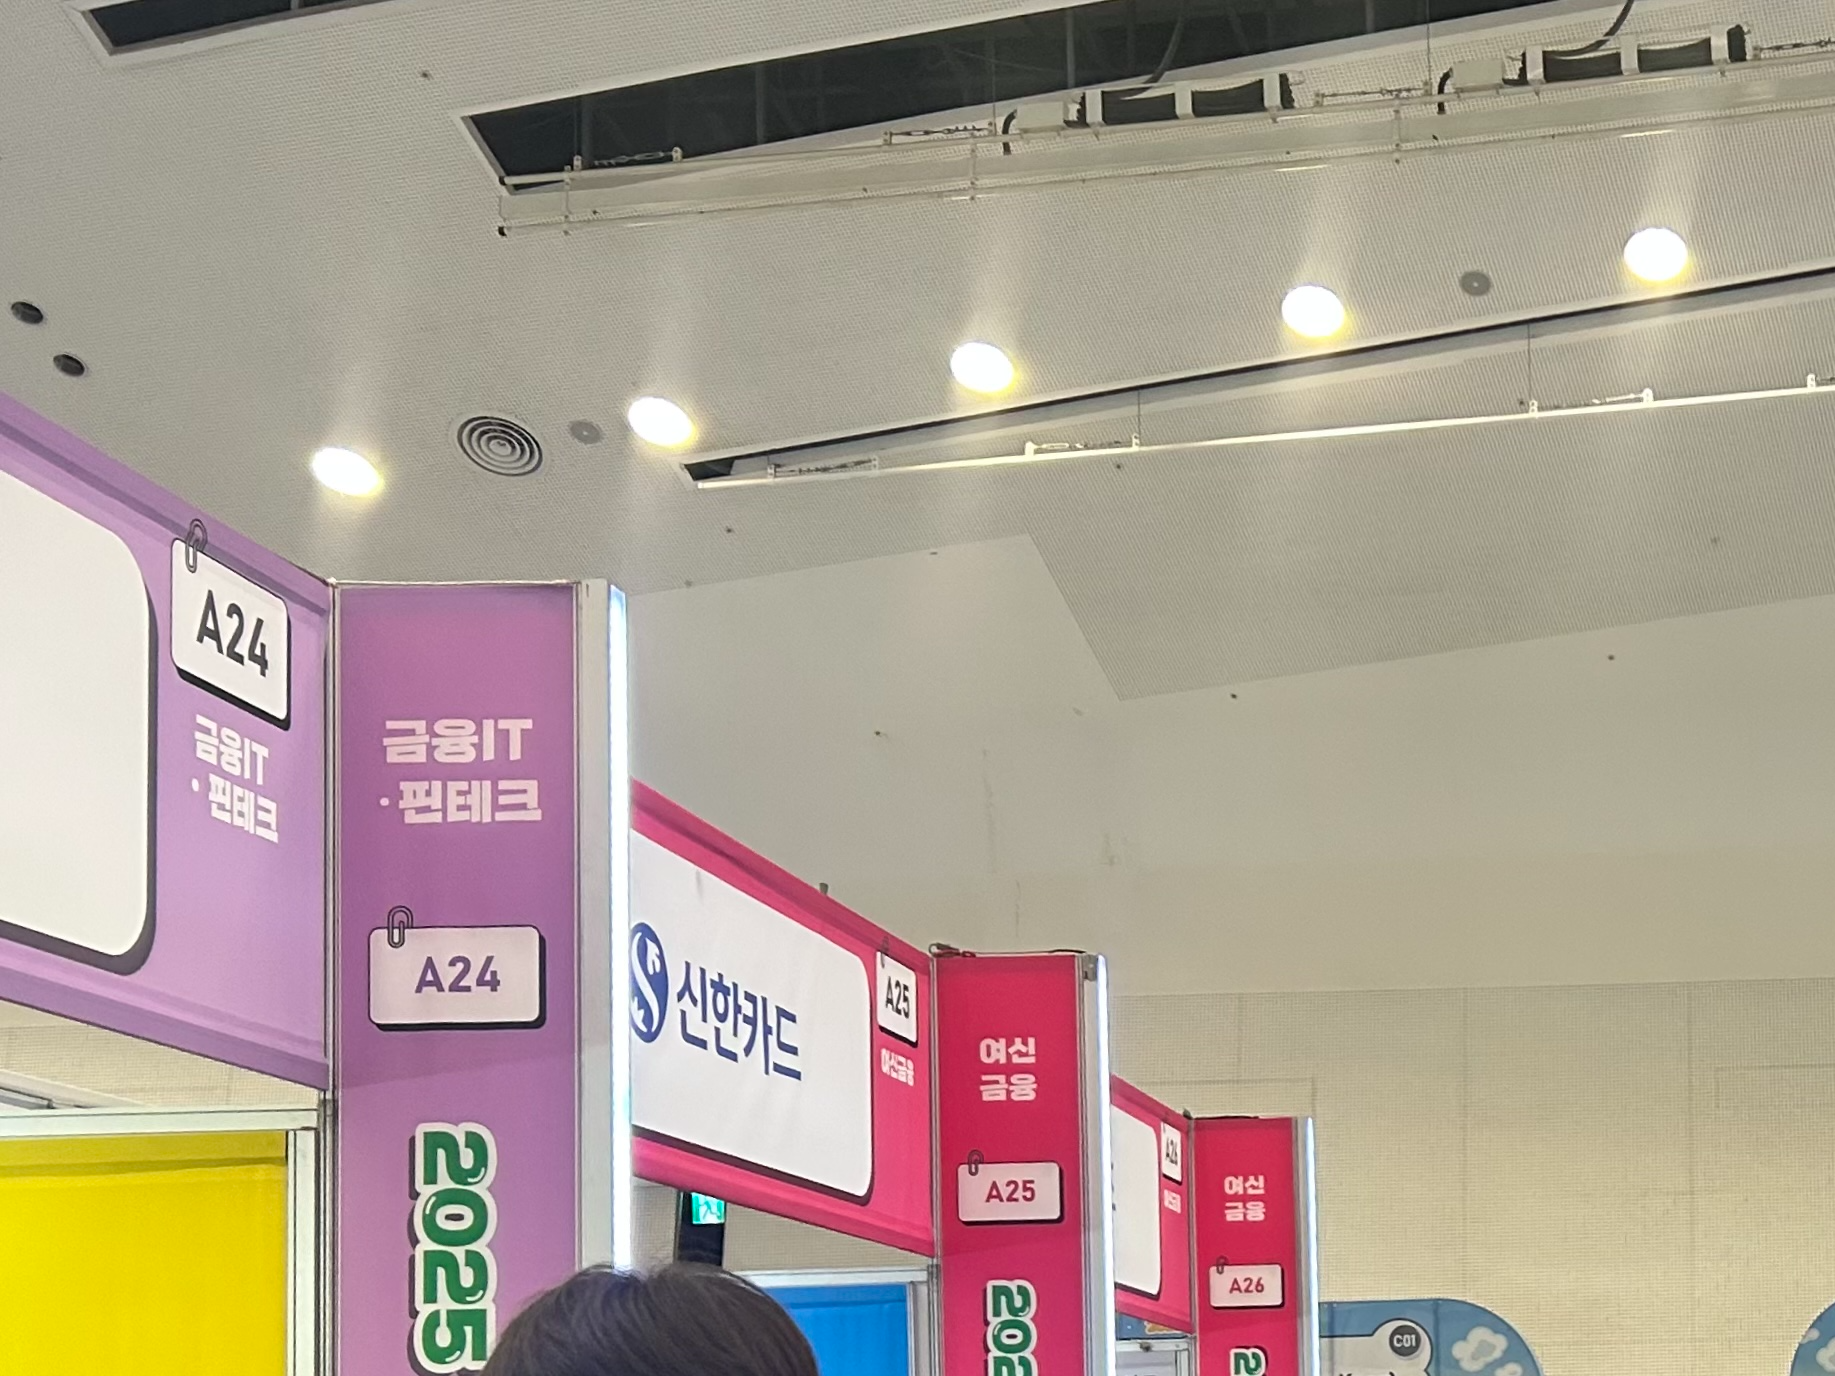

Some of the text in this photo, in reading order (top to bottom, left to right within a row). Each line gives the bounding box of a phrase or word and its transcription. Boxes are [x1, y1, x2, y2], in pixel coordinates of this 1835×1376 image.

[196, 588, 269, 678] A24
[195, 713, 269, 787] 금융IT
[382, 718, 533, 765] 금융IT
[413, 955, 501, 994] A24
[885, 975, 910, 1019] A25
[676, 959, 802, 1082] 신한카드
[979, 1035, 1037, 1065] 여신
[979, 1072, 1038, 1103] 금융
[985, 1179, 1037, 1204] A25
[1223, 1174, 1265, 1197] 여신
[1223, 1201, 1266, 1223] 금융
[421, 1130, 489, 1365] 2025
[1228, 1277, 1265, 1295] A26
[1393, 1333, 1417, 1348] C01
